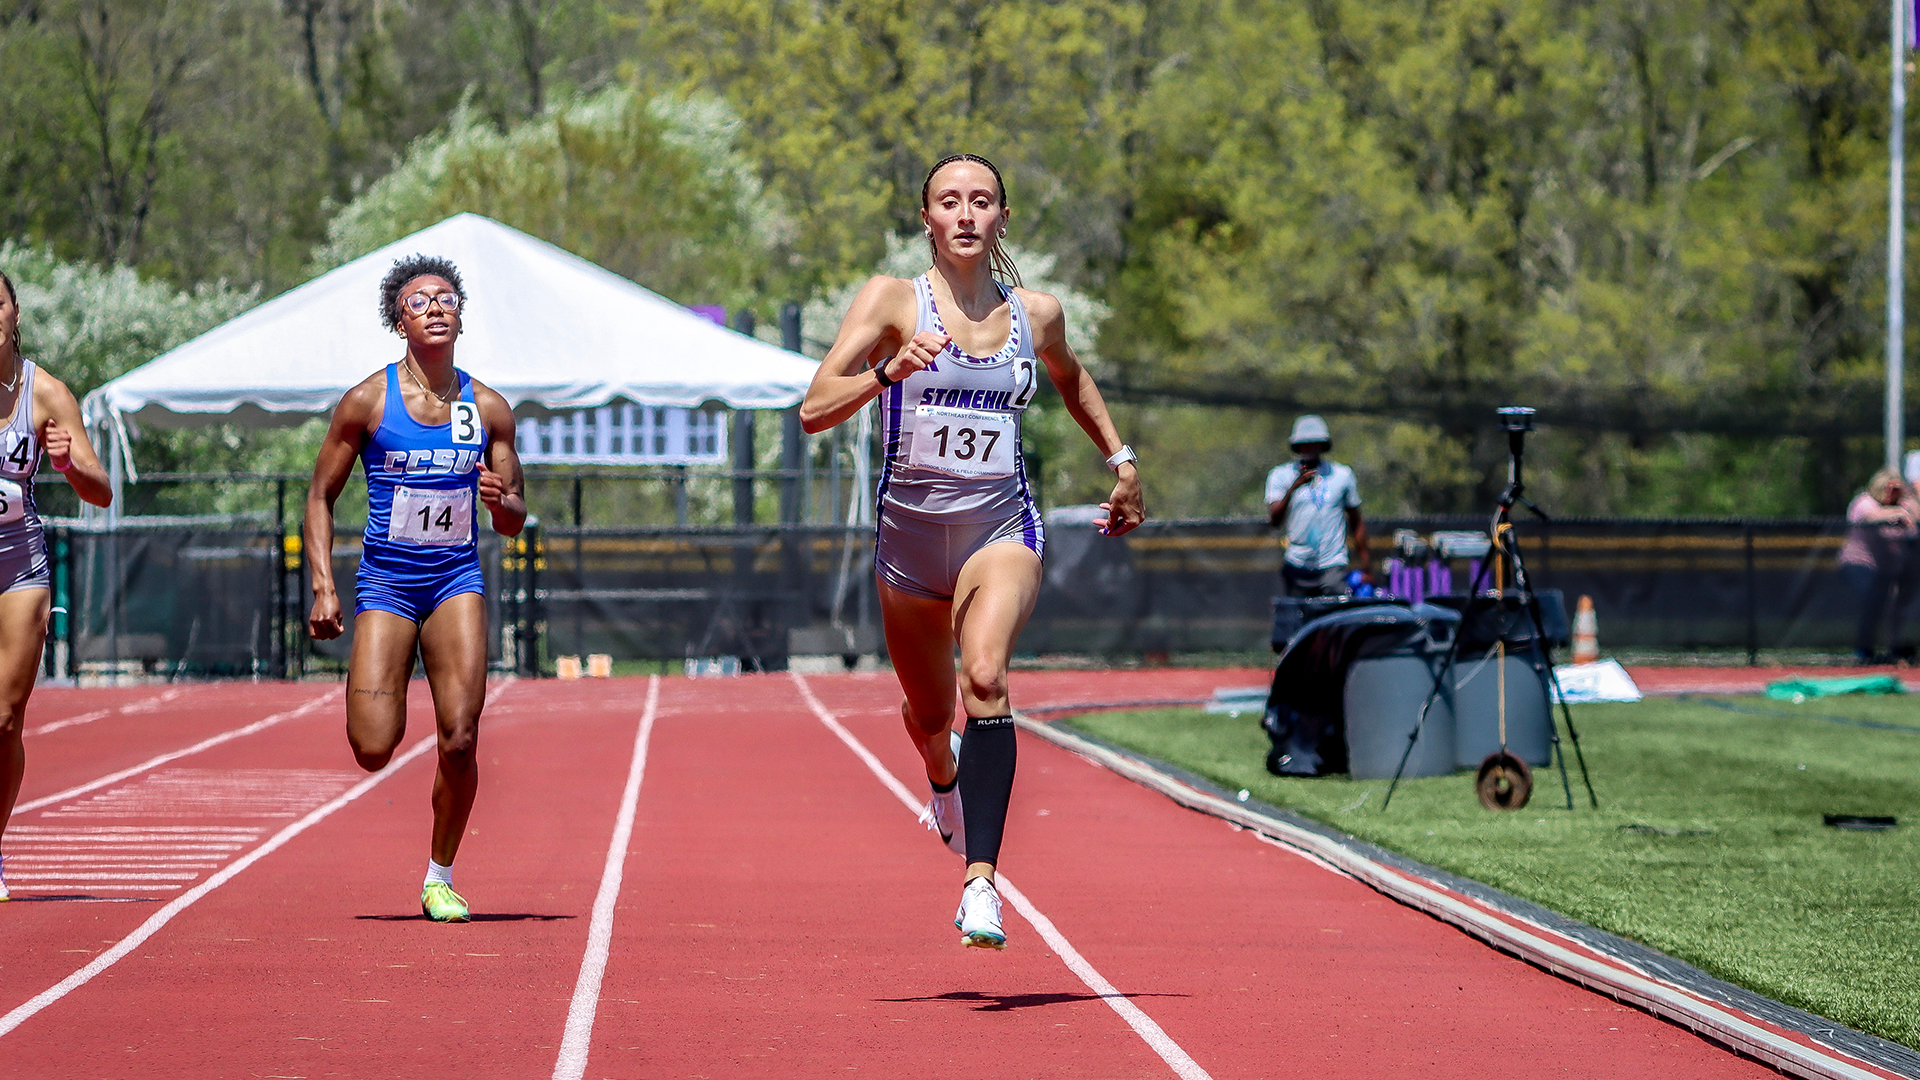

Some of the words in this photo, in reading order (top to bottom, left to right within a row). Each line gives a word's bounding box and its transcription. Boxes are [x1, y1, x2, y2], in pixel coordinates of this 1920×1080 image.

[920, 387, 1018, 410] STONEHIL
[1015, 361, 1032, 406] 2
[457, 405, 475, 441] 3
[936, 411, 967, 419] NORTHEAST
[9, 436, 29, 471] 4
[933, 425, 1001, 462] 137
[383, 448, 479, 475] CCSU
[417, 505, 453, 532] 14
